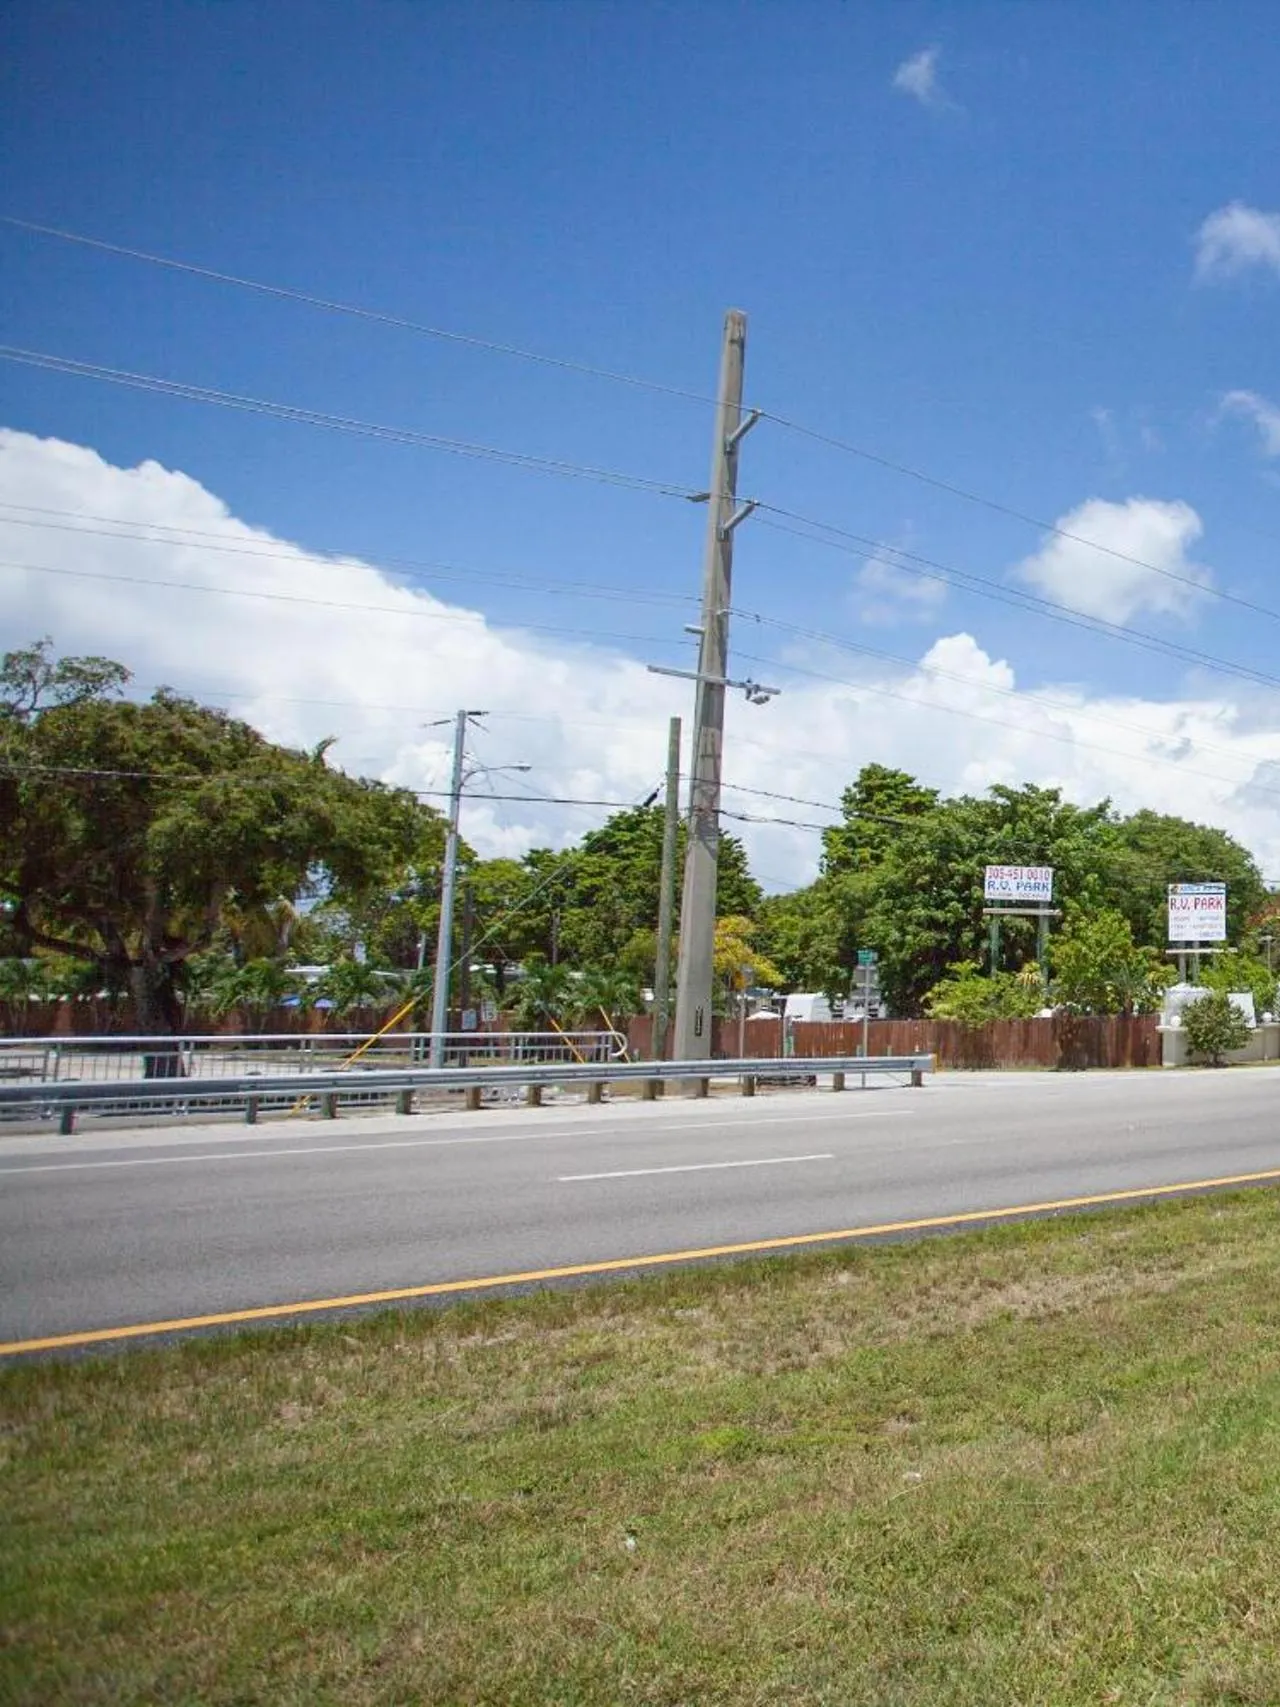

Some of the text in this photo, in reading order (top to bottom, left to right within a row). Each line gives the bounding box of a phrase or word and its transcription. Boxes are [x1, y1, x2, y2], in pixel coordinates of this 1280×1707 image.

[987, 880, 1049, 892] R.V. PARK
[1170, 897, 1223, 911] R.V. PARK
